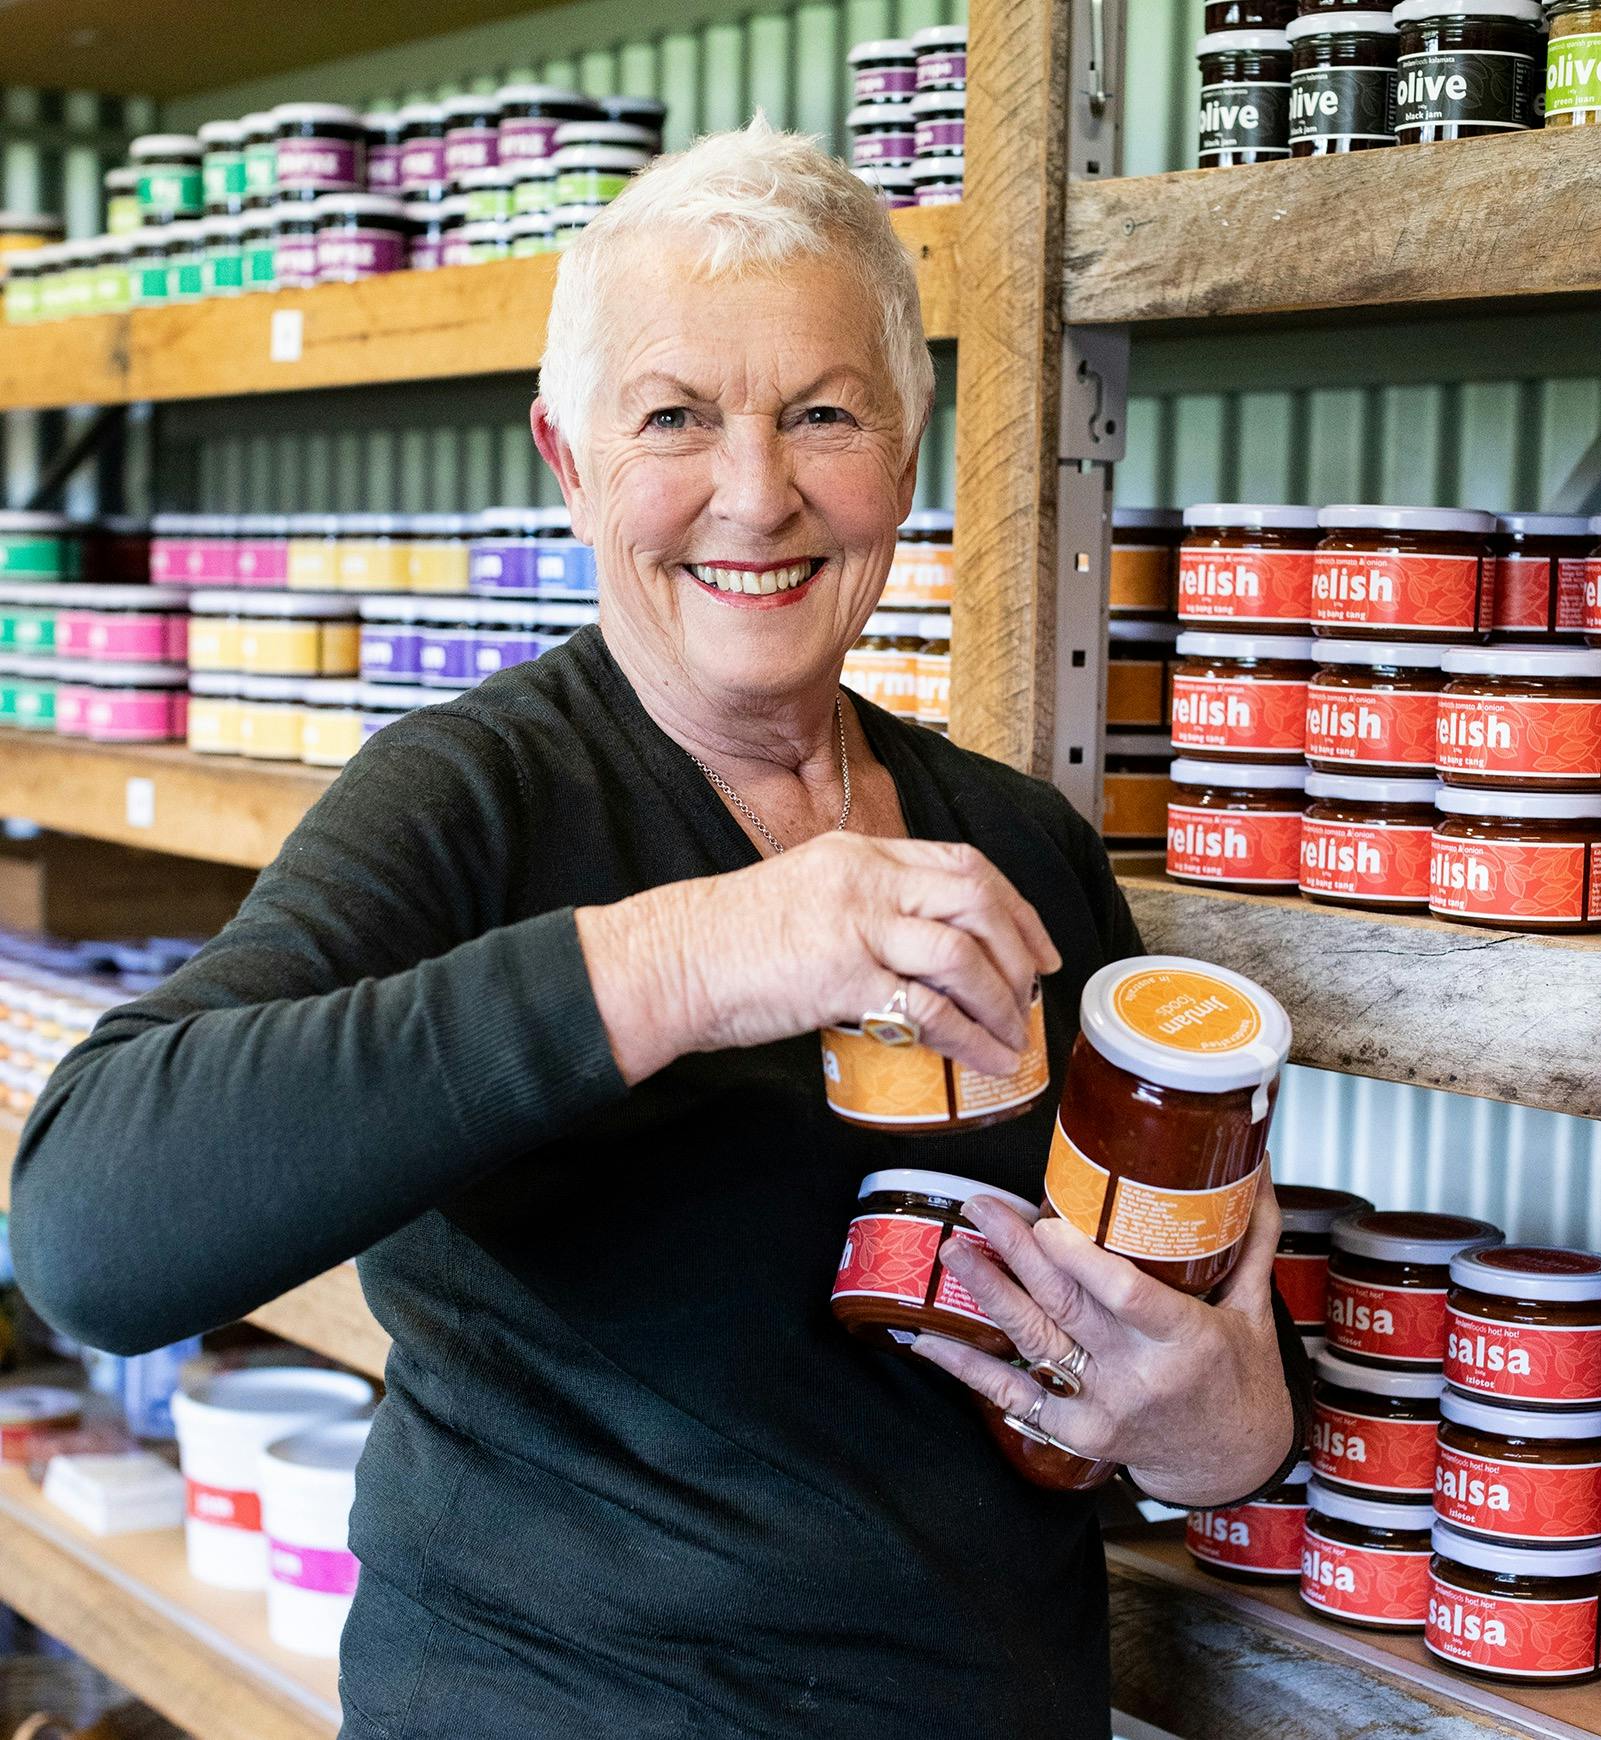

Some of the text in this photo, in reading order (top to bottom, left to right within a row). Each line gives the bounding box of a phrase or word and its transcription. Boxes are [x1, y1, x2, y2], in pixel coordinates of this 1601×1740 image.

[1397, 69, 1468, 106] olive
[1547, 52, 1601, 91] oliv
[1405, 110, 1443, 121] black jam
[1179, 563, 1259, 597] relish
[1311, 567, 1393, 602] relish
[1172, 692, 1250, 728] relish
[1306, 703, 1382, 740] relish
[1465, 756, 1485, 768] tang
[1168, 823, 1247, 859] relish
[1300, 837, 1380, 874] relish
[1155, 993, 1197, 1017] foods
[1158, 995, 1230, 1035] JimJam
[1488, 1324, 1503, 1336] hot!
[1504, 1328, 1520, 1339] hot!
[1448, 1332, 1531, 1376] salsa
[1313, 1422, 1367, 1463] alsa
[1470, 1460, 1500, 1475] hot! hot!
[1435, 1464, 1511, 1512] salsa
[1302, 1548, 1356, 1594] alsa
[1465, 1595, 1479, 1607] hot!
[1480, 1599, 1497, 1610] hot!
[1429, 1598, 1507, 1648] salsa
